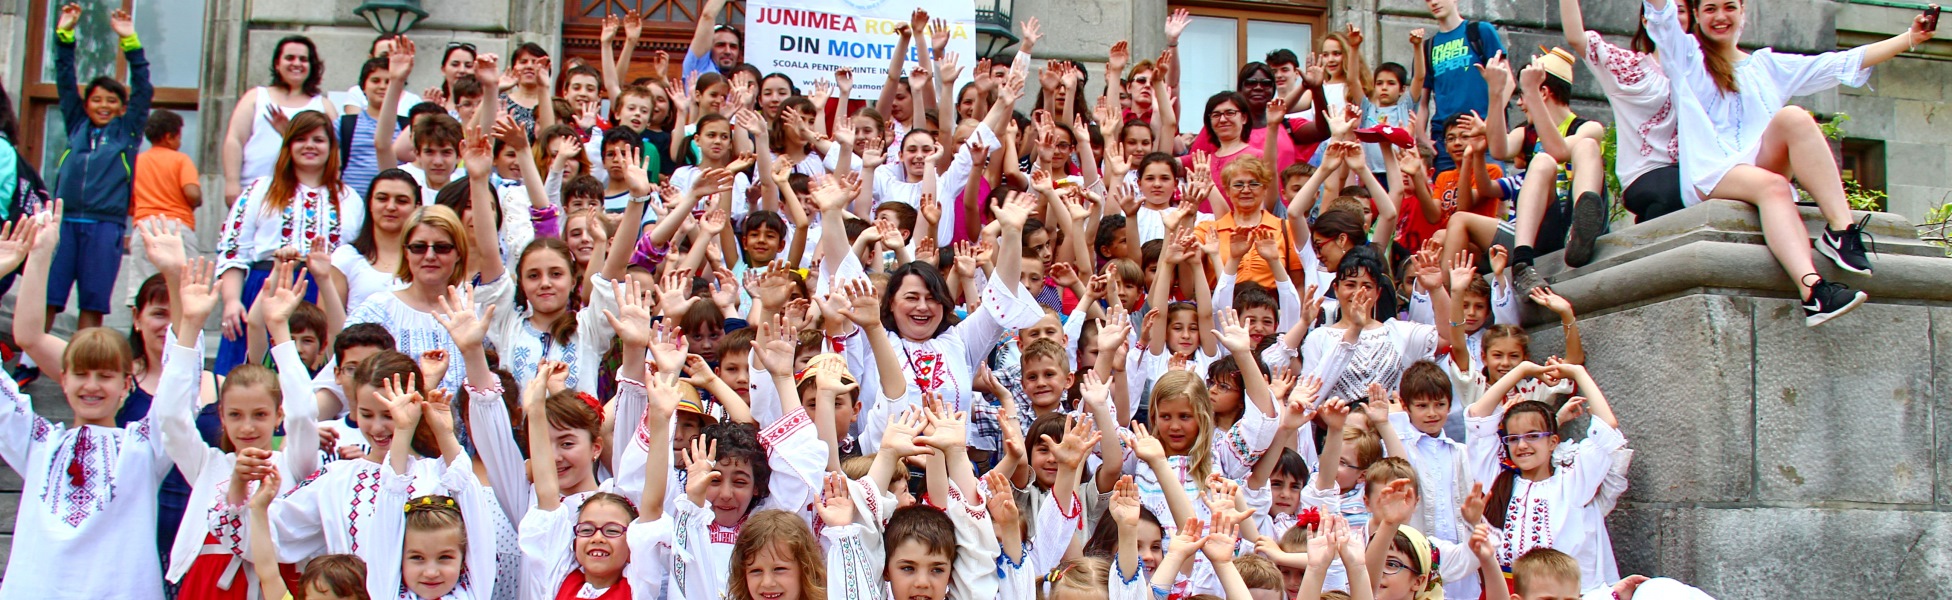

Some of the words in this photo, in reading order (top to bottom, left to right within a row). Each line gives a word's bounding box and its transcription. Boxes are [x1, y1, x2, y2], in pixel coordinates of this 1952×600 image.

[756, 7, 858, 33] JUNIMEA
[780, 35, 820, 54] DIN
[812, 63, 846, 72] PENTR
[1433, 55, 1473, 77] EPEAT
